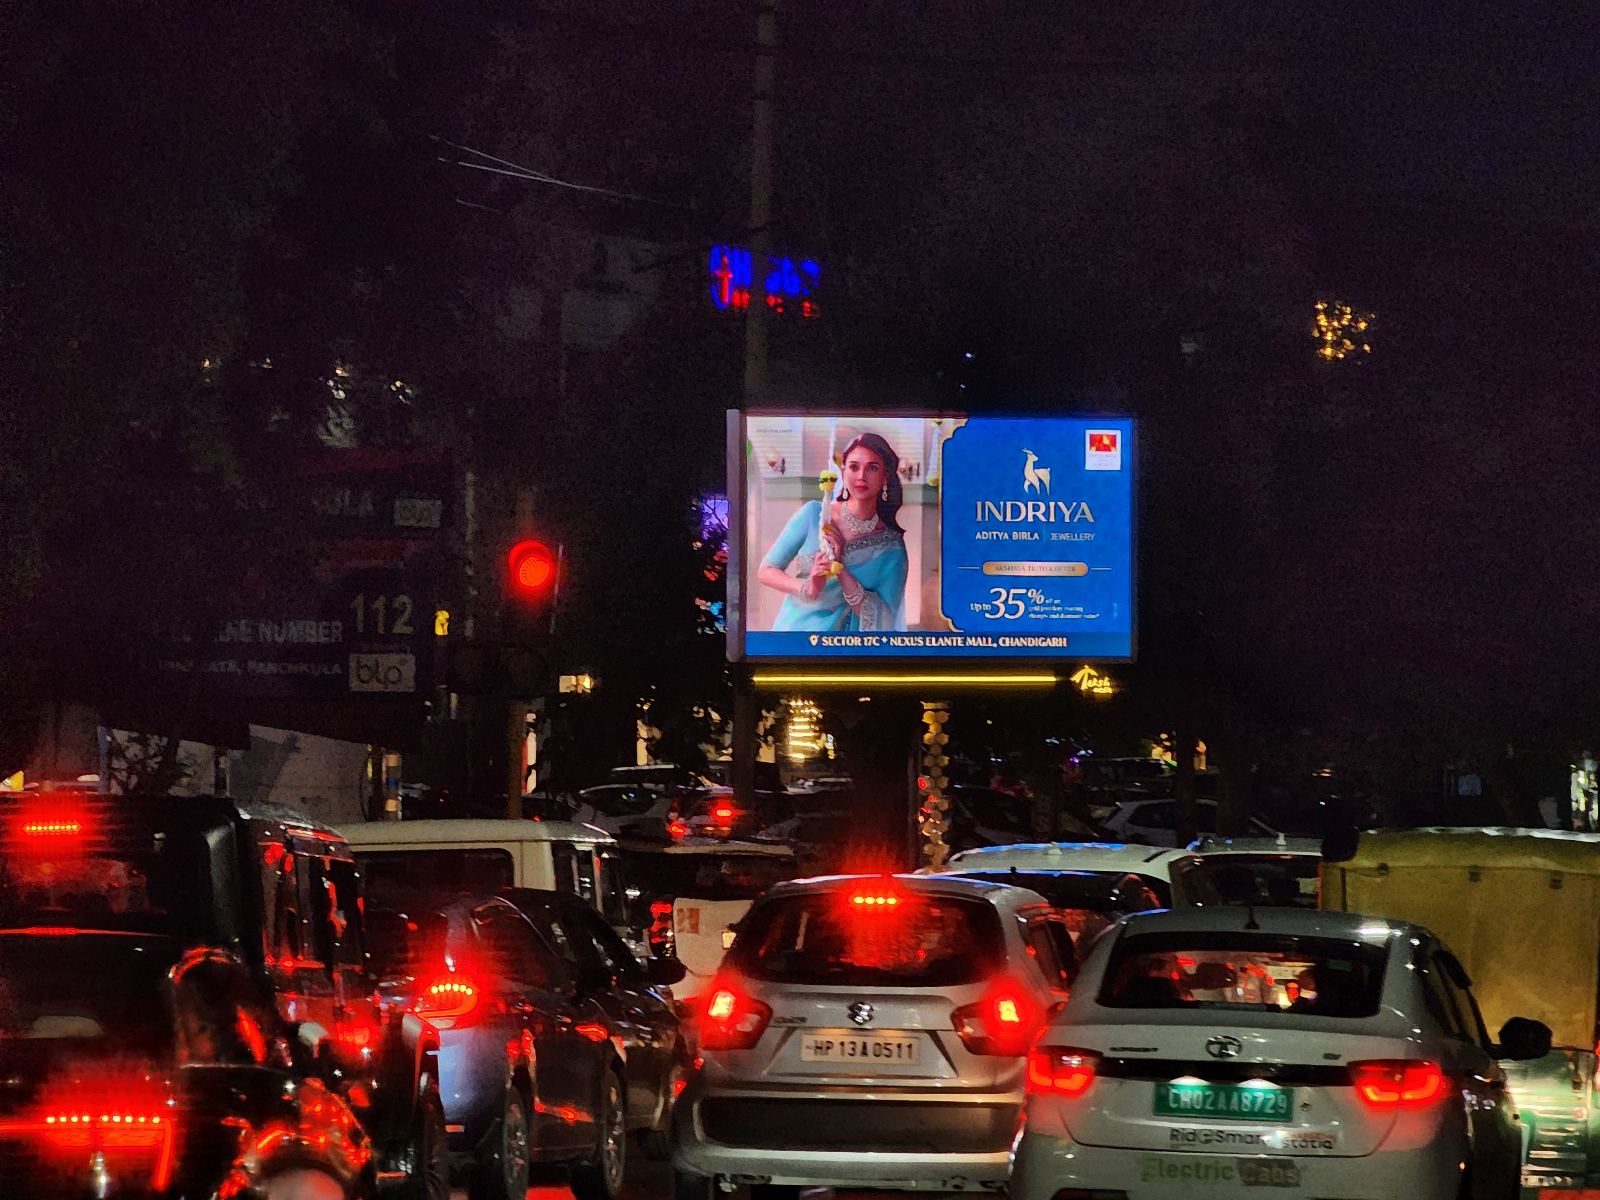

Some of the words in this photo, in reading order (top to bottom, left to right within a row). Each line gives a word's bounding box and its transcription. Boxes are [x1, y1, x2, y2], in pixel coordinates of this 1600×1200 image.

[976, 500, 1095, 523] INDRIYA
[975, 531, 1009, 541] ADITYA
[1012, 531, 1040, 541] BIRLA
[1050, 532, 1096, 542] JEWELLERY
[351, 593, 416, 635] 112
[257, 619, 343, 643] NUMBER
[821, 635, 862, 647] SECTOR
[863, 635, 880, 647] 17C
[890, 636, 923, 648] NEXUS
[925, 636, 965, 648] ELANTE
[966, 636, 997, 648] MALL,
[998, 636, 1068, 648] CHANDIGARH
[1141, 1157, 1235, 1183] Electric
